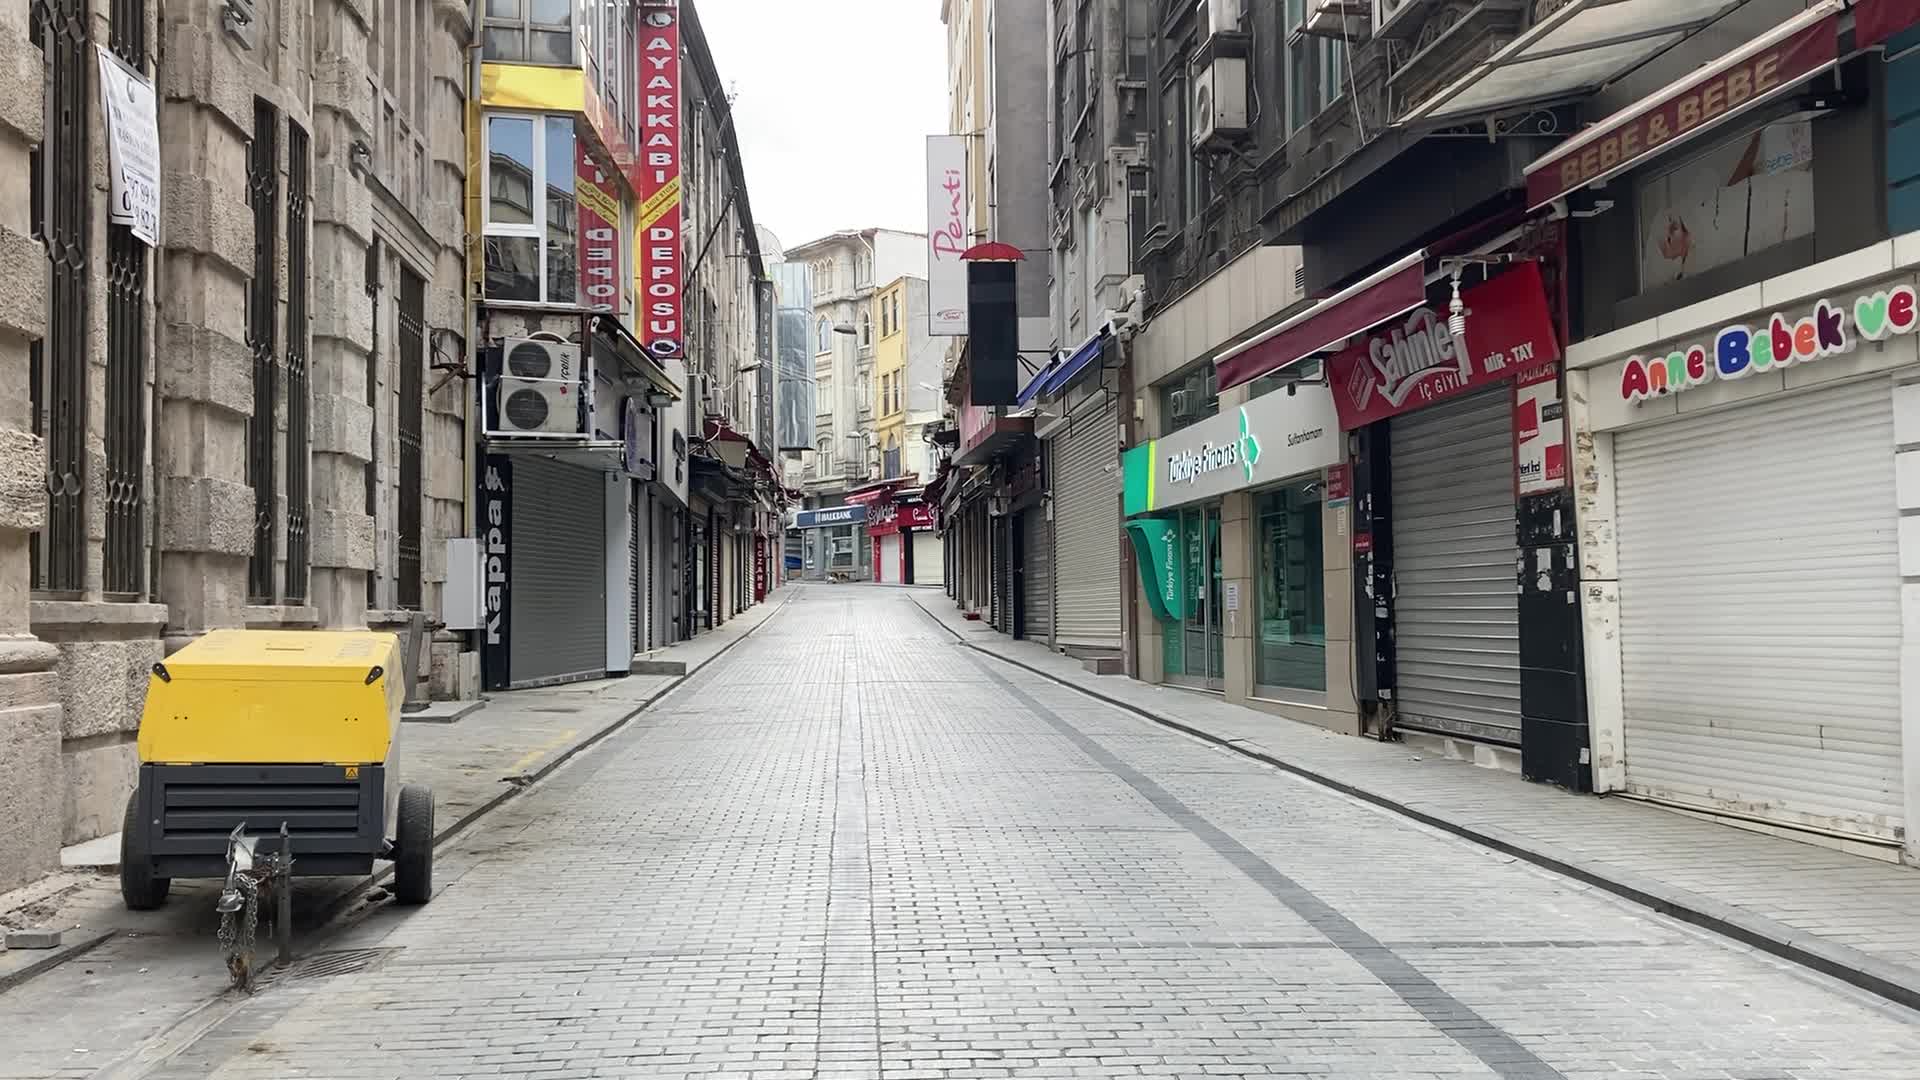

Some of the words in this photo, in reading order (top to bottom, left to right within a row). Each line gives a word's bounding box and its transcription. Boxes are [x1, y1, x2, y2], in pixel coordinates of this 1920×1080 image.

[646, 37, 674, 183] AYAKKABI
[1560, 125, 1641, 189] BEBE
[1647, 114, 1671, 145] &
[1678, 52, 1779, 131] BEBE
[933, 170, 965, 261] Penti
[649, 228, 676, 333] DEPOSU
[1419, 382, 1432, 400] İÇ
[1435, 370, 1464, 393] GİYİ
[1484, 352, 1506, 373] MİR
[1511, 341, 1534, 363] TAY
[1621, 347, 1705, 400] Anne
[1716, 301, 1845, 377] Bebek
[1856, 288, 1916, 338] ve
[1168, 450, 1200, 484] Türkiye
[1202, 442, 1236, 472] Finans
[488, 500, 506, 644] Kappa
[1167, 571, 1175, 600] Türkiye
